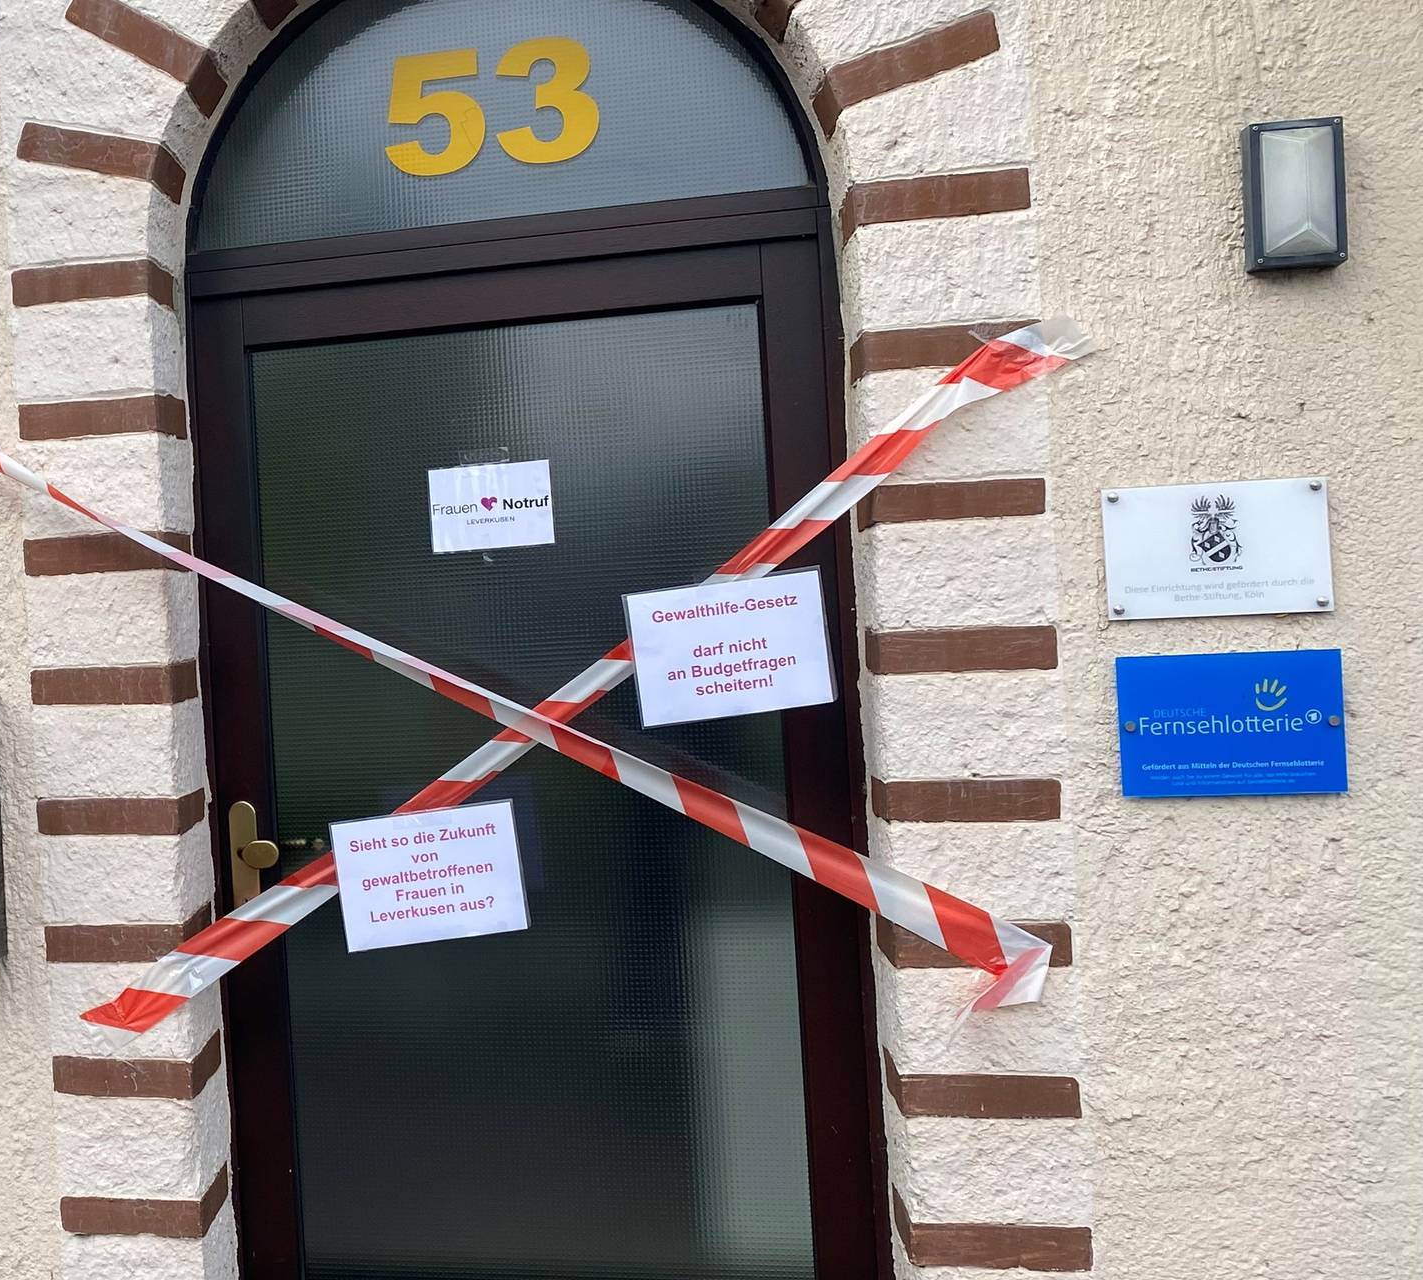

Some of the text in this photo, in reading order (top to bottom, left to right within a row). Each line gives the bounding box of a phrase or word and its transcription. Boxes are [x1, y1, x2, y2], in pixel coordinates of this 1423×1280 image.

[385, 36, 600, 176] 53
[432, 495, 549, 516] Frauen Notruf
[466, 516, 515, 525] LEVERKUSEN
[1124, 577, 1314, 594] Diese Einrichtung wird gefördert durch die
[1174, 590, 1265, 602] Bethe-Stiftung, Köln
[651, 594, 798, 623] Gewalthilfe-Gesetz
[693, 636, 768, 658] darf nicht
[667, 654, 796, 681] an Budgetfragen
[695, 674, 773, 696] scheitern!
[1153, 707, 1207, 718] DEUTSCHE
[1139, 714, 1304, 736] Fernsehlotterie
[1141, 763, 1177, 771] Gefördert
[1191, 762, 1217, 770] Mitteln
[1218, 761, 1230, 769] der
[1232, 760, 1270, 769] Deutschen
[1270, 759, 1325, 768] Fernsehlotterie
[349, 823, 496, 853] Sieht so die Zukunft
[411, 851, 439, 864] von
[362, 862, 493, 891] gewaltbetroffenen
[395, 882, 465, 902] Frauen in
[369, 895, 495, 923] Leverkusen aus?
